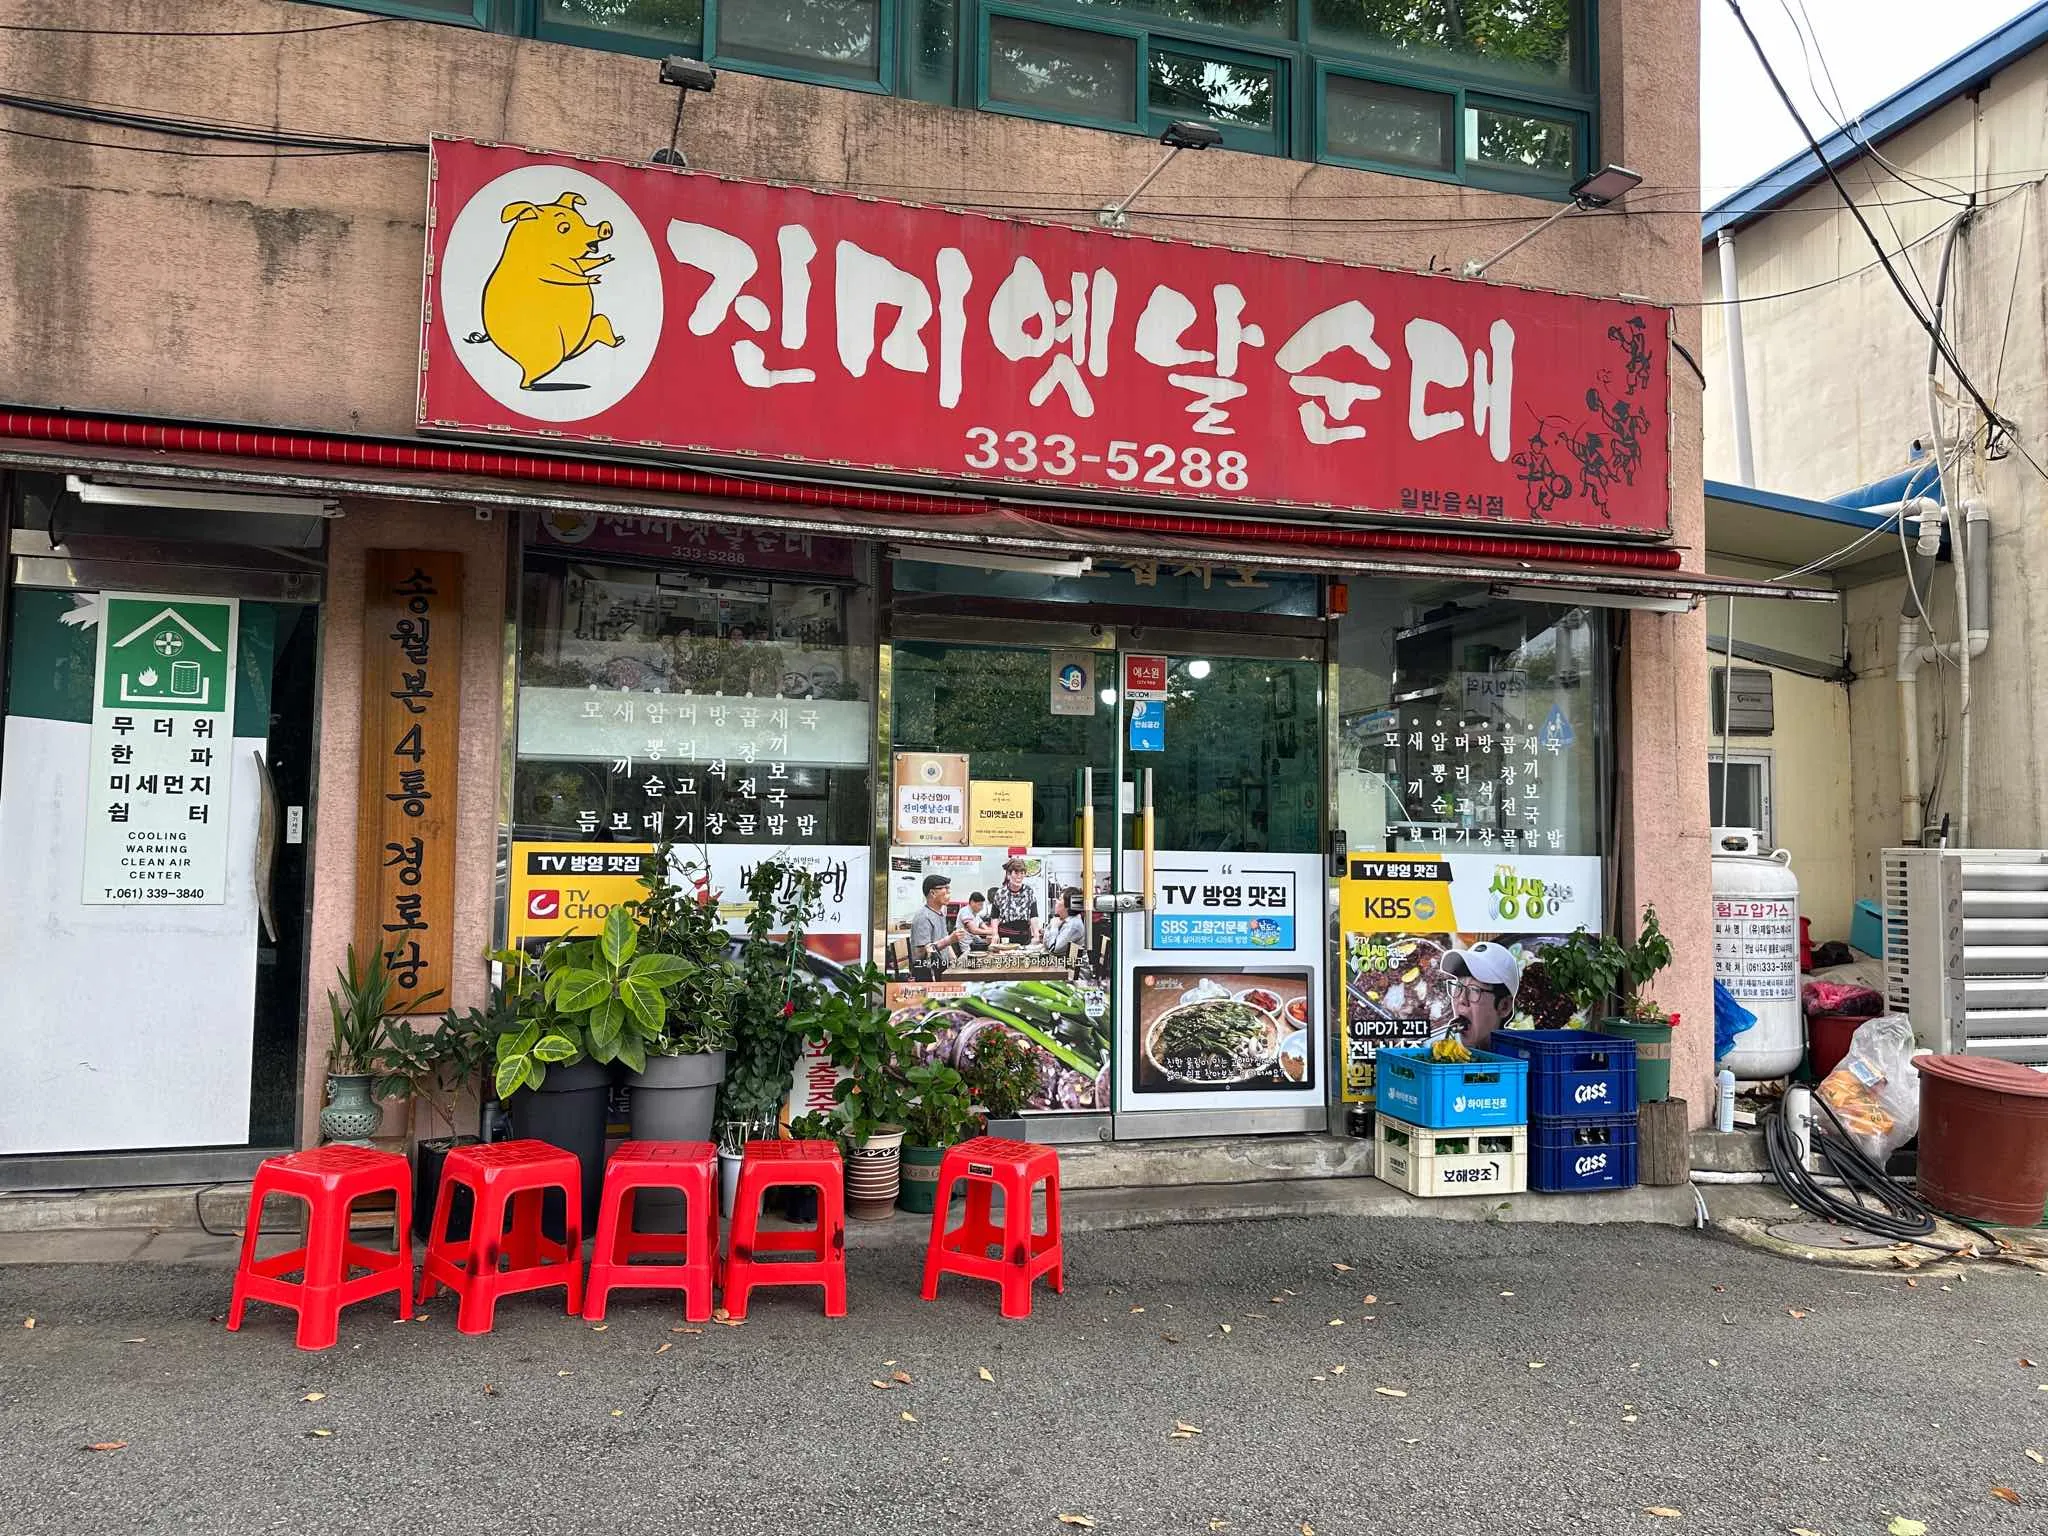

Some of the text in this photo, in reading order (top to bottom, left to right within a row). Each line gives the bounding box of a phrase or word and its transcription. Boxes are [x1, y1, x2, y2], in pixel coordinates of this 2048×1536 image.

[667, 218, 1515, 463] 진미옛날순대
[964, 427, 1249, 490] 333-5288
[1401, 487, 1504, 517] 일반음식점
[111, 716, 214, 738] 무더위
[110, 774, 211, 795] 미세먼지
[128, 831, 187, 841] COOLING
[126, 845, 188, 854] WARMING
[121, 857, 191, 867] CLEAN AIR
[538, 855, 640, 872] TV 방영 맛집
[129, 870, 182, 880] CENTER
[1363, 863, 1438, 878] TV 방영 맛집
[105, 888, 204, 900] T.061) 339-3840
[566, 889, 590, 902] TV
[1162, 885, 1287, 908] TV 방영 맛집
[383, 837, 429, 989] 경로당
[1365, 896, 1411, 919] KBS
[1161, 920, 1189, 935] SBS
[1354, 1020, 1429, 1036] 이PD가 간다
[1574, 1082, 1607, 1104] Cass
[1467, 1097, 1508, 1109] 하이트진로
[1574, 1152, 1607, 1174] Cass
[1443, 1168, 1493, 1183] 보해양조
